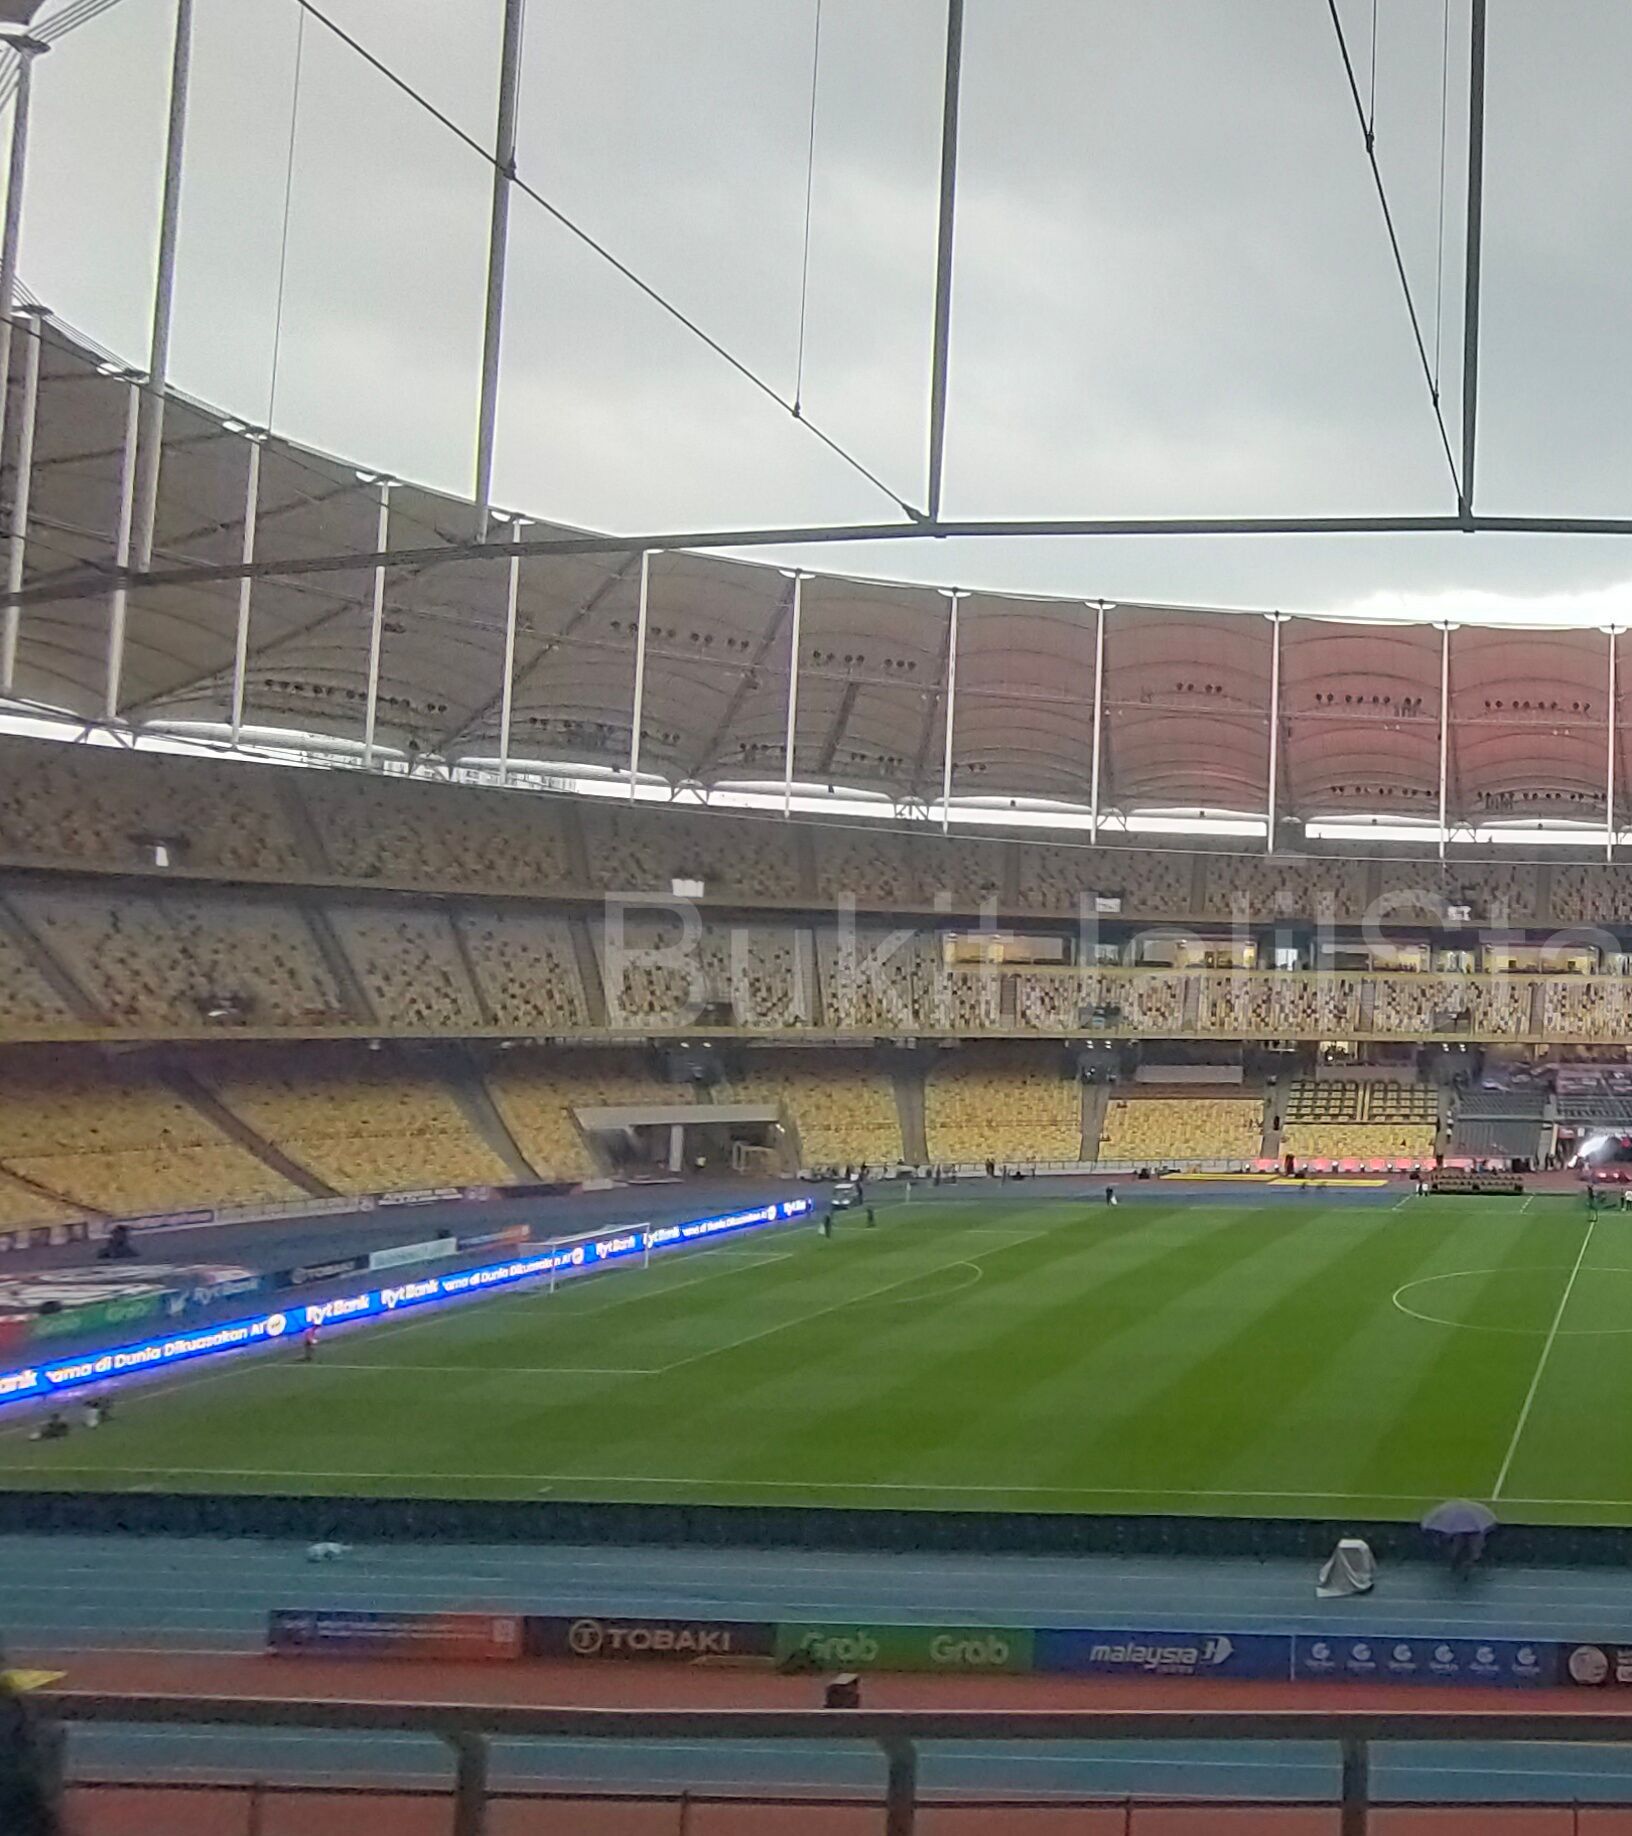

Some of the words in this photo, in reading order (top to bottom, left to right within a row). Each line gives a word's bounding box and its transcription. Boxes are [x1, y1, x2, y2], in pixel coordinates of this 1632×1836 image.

[114, 1346, 161, 1369] Dunia
[607, 1627, 731, 1652] TOBAKI
[804, 1631, 878, 1662] Grab
[931, 1634, 1009, 1665] Grab
[1089, 1642, 1199, 1669] malaysia
